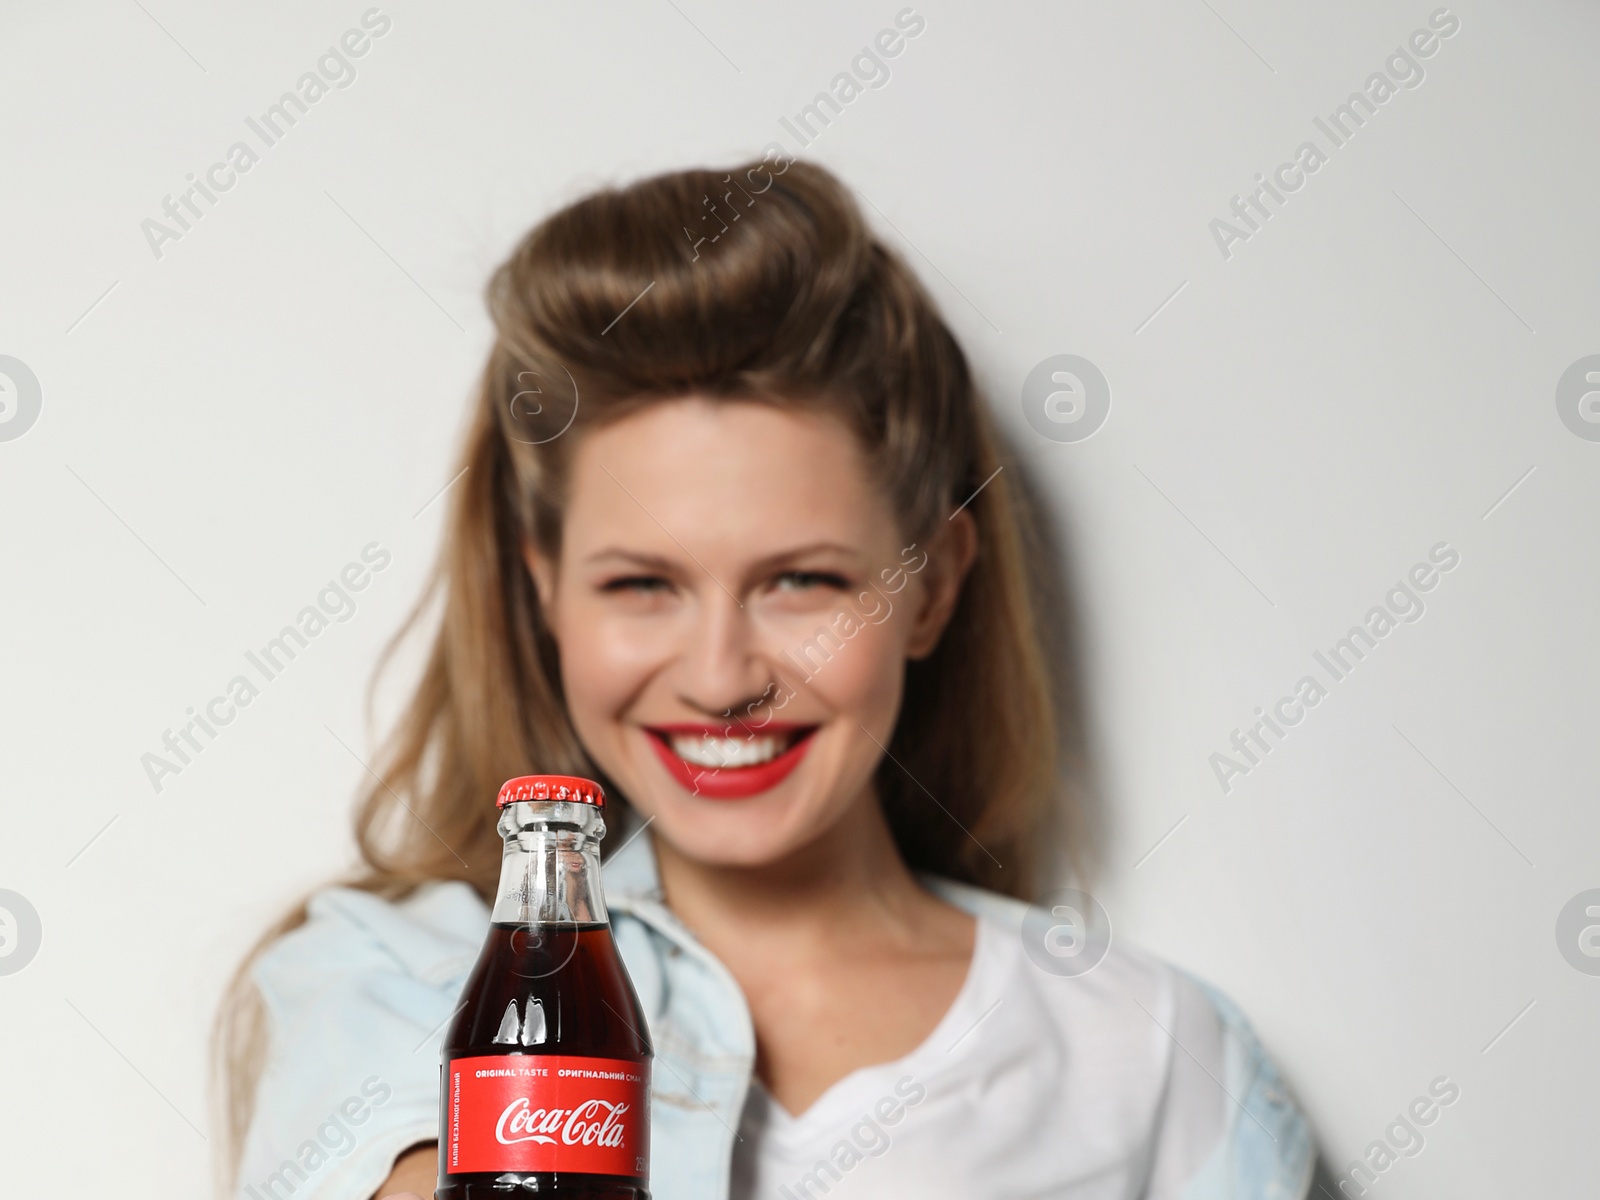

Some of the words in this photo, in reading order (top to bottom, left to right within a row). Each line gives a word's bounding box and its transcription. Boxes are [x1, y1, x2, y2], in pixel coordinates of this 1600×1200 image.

[475, 1068, 516, 1078] ORIGINAL
[519, 1068, 548, 1077] TASTE
[558, 1069, 625, 1081] ОРИГІНАЛЬНИЙ
[495, 1097, 630, 1148] Coca-Cola
